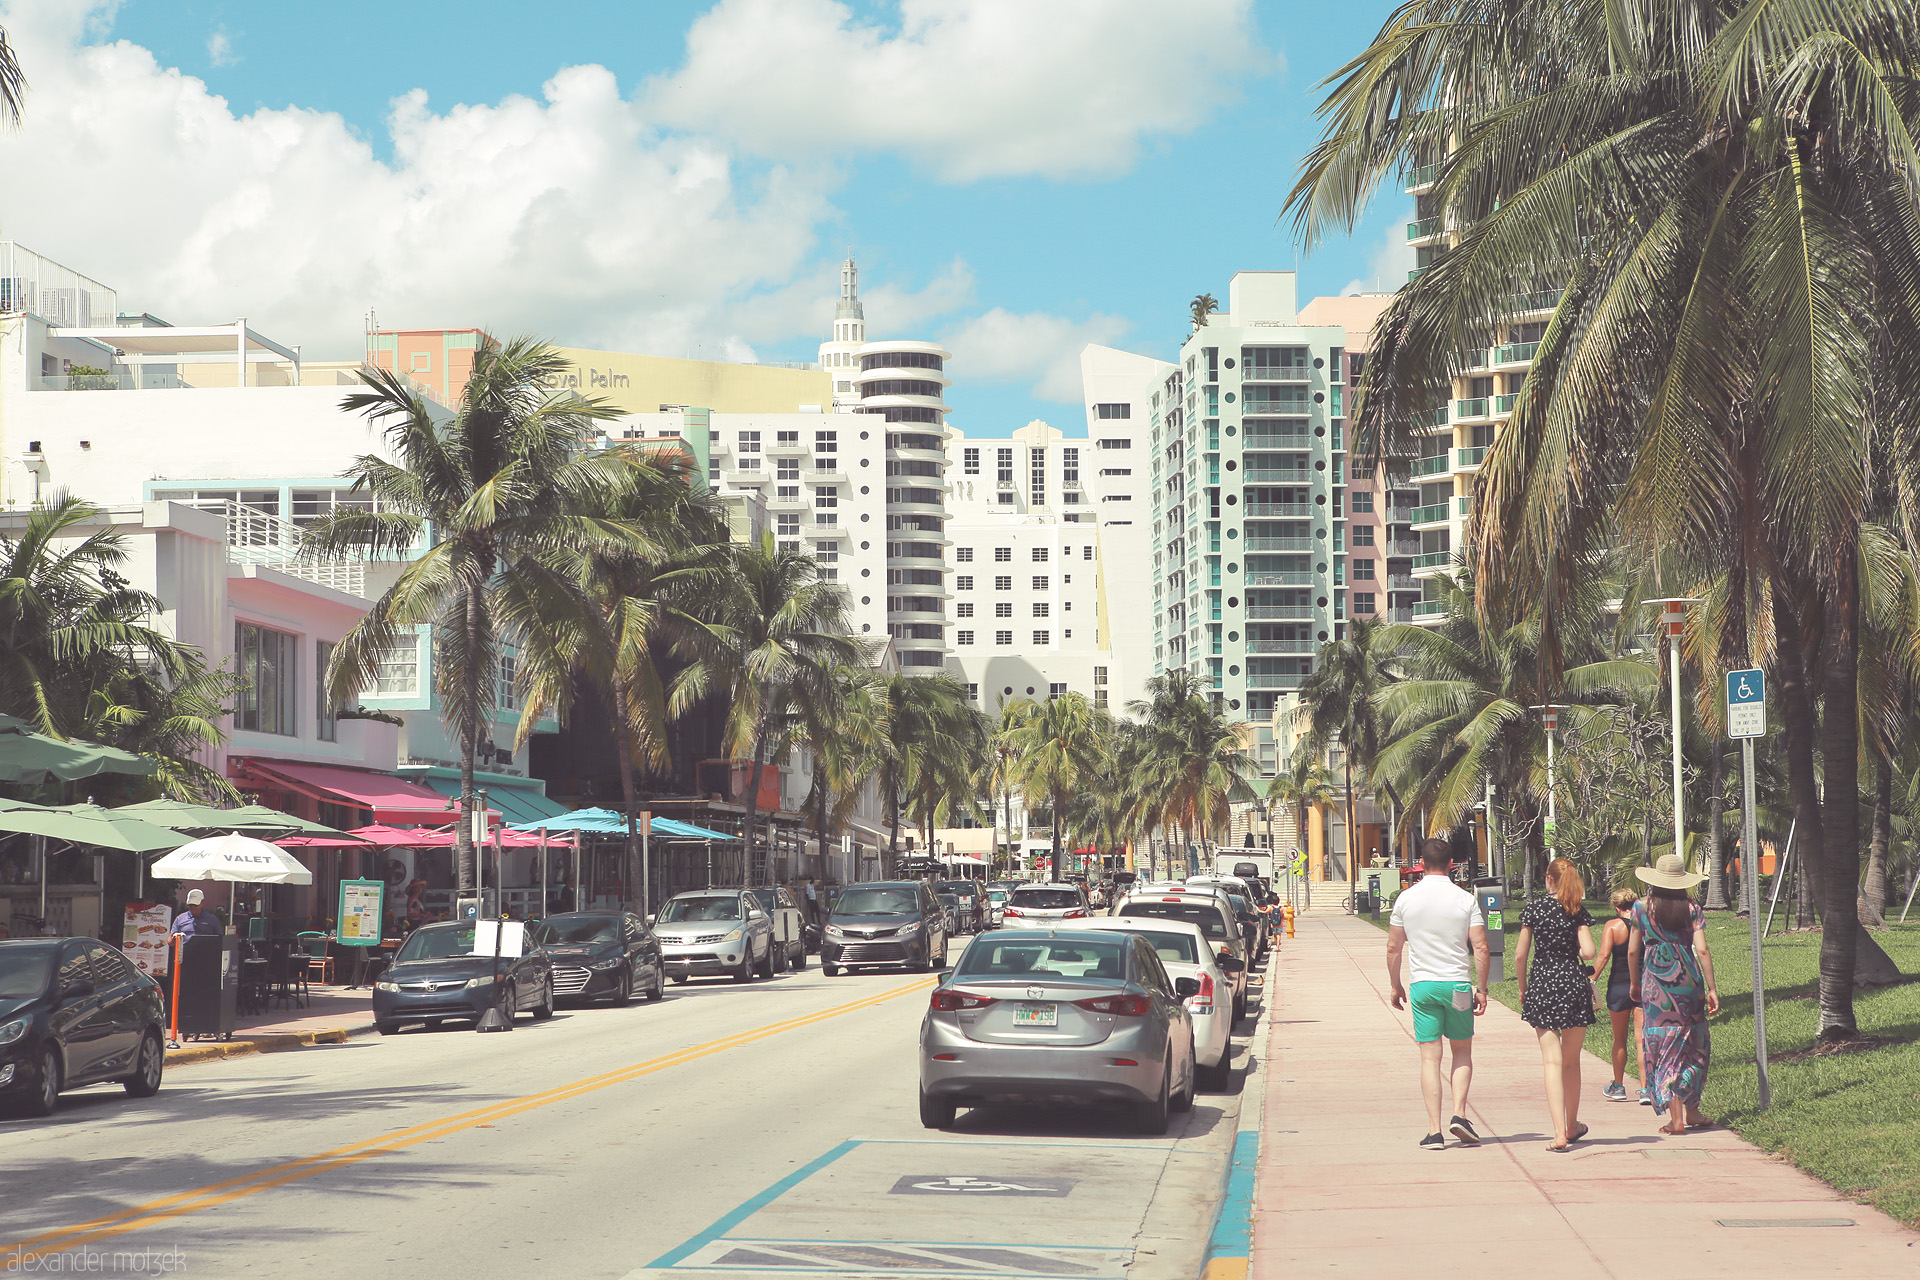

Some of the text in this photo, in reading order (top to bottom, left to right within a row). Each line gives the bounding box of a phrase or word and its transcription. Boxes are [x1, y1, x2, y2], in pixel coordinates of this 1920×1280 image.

[590, 368, 629, 388] Palm
[223, 854, 272, 864] VALET
[1487, 896, 1496, 907] P
[468, 907, 476, 917] P
